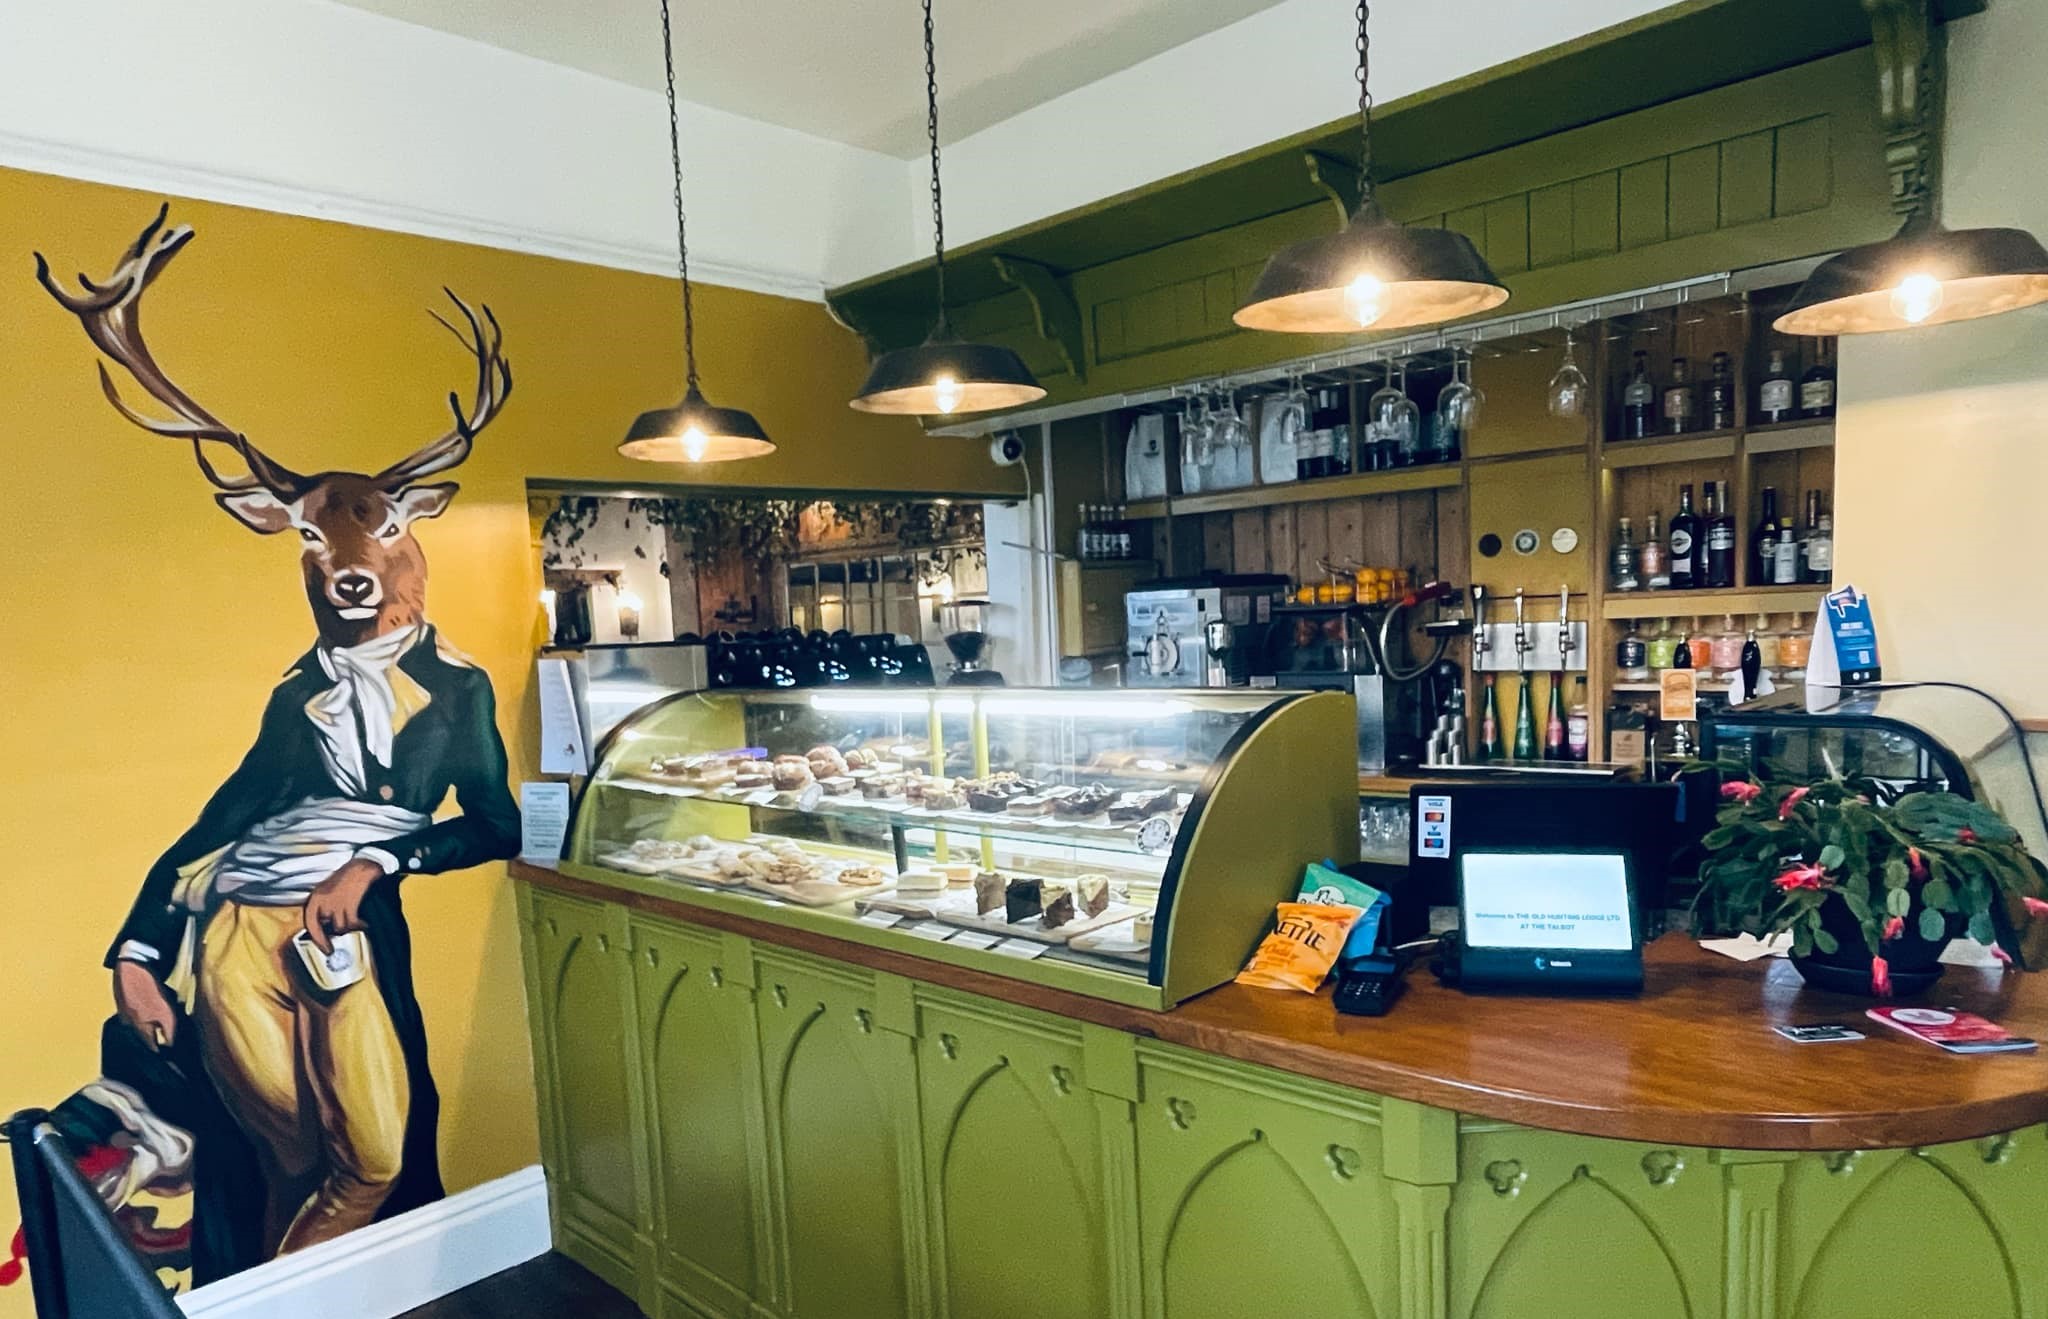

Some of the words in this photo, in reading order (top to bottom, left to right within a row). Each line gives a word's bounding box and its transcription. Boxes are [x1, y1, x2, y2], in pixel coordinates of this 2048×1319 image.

[1475, 912, 1506, 920] Welcome
[1516, 912, 1530, 920] THE
[1581, 914, 1605, 922] LODGE
[1606, 914, 1621, 922] LTD
[1547, 923, 1576, 931] TALBOT
